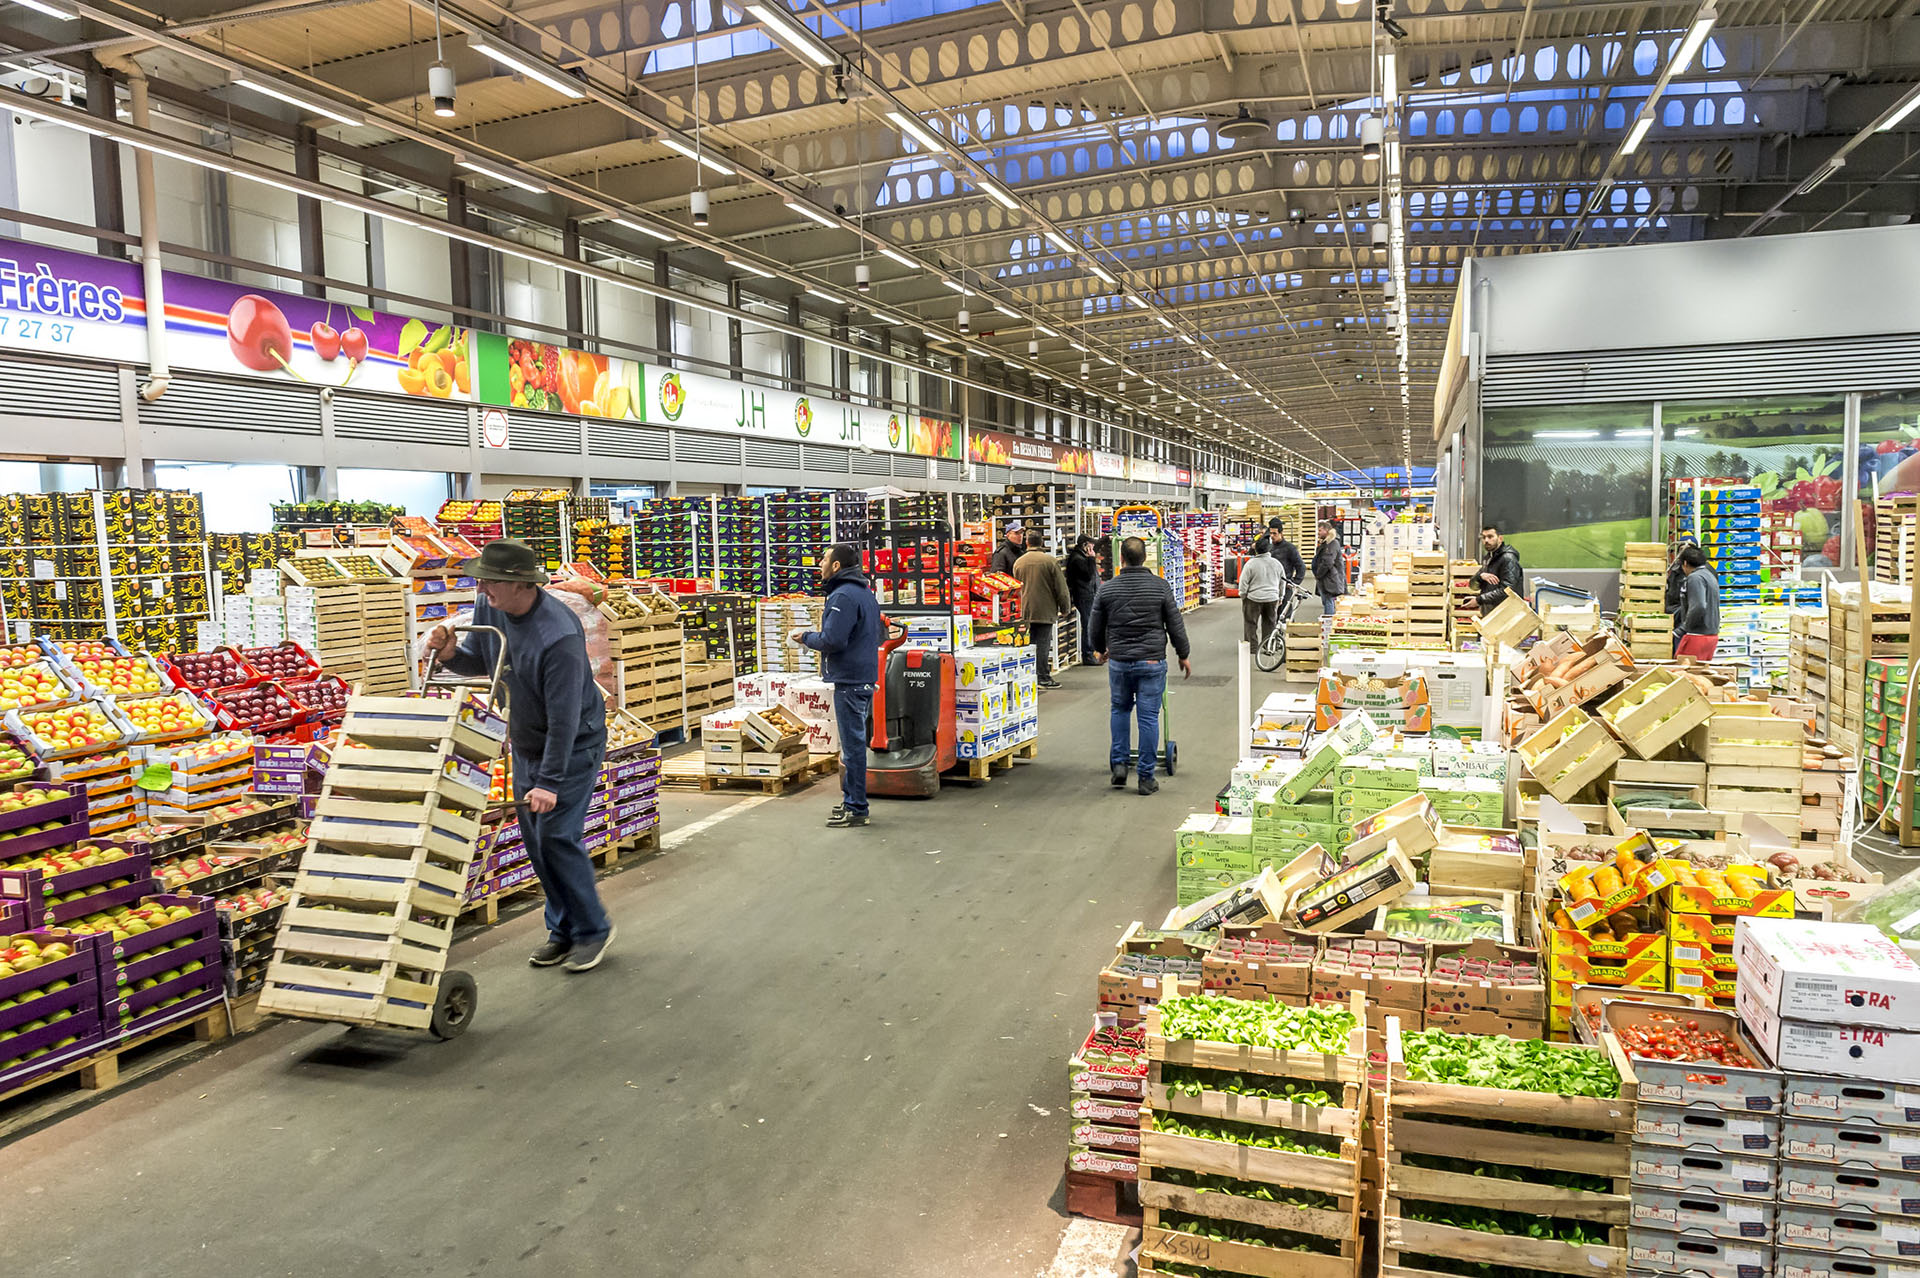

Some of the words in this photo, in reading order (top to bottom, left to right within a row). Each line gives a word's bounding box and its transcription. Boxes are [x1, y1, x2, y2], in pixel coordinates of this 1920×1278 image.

[0, 260, 124, 323] Frères
[19, 318, 42, 339] 27
[51, 323, 74, 343] 37
[736, 388, 765, 429] J.H
[839, 407, 861, 441] J.H
[799, 692, 820, 705] Hurdy
[959, 743, 975, 757] G
[1453, 761, 1489, 770] AMBAR
[1603, 887, 1640, 910] SHARON
[1712, 898, 1754, 909] SHARON
[1711, 928, 1735, 937] SHA
[1588, 944, 1628, 955] SHARON
[1711, 956, 1735, 966] SHA
[1588, 968, 1628, 979] SHARON
[1712, 983, 1736, 992] SHA
[1090, 1076, 1138, 1090] berrystars
[1641, 1087, 1679, 1098] MERCA4
[1795, 1097, 1835, 1107] MERCA4
[1091, 1103, 1138, 1118] berrystars
[1639, 1124, 1676, 1134] MERCA4
[1092, 1130, 1139, 1145] berrystars
[1792, 1145, 1831, 1155] MERCA4
[1090, 1157, 1137, 1171] berrystars
[1639, 1166, 1677, 1177] MERCA4
[1791, 1186, 1831, 1197] MERCA4
[1636, 1209, 1674, 1220] MERCA4
[1788, 1229, 1827, 1240] MERCA4
[1634, 1251, 1671, 1262] MERCA4
